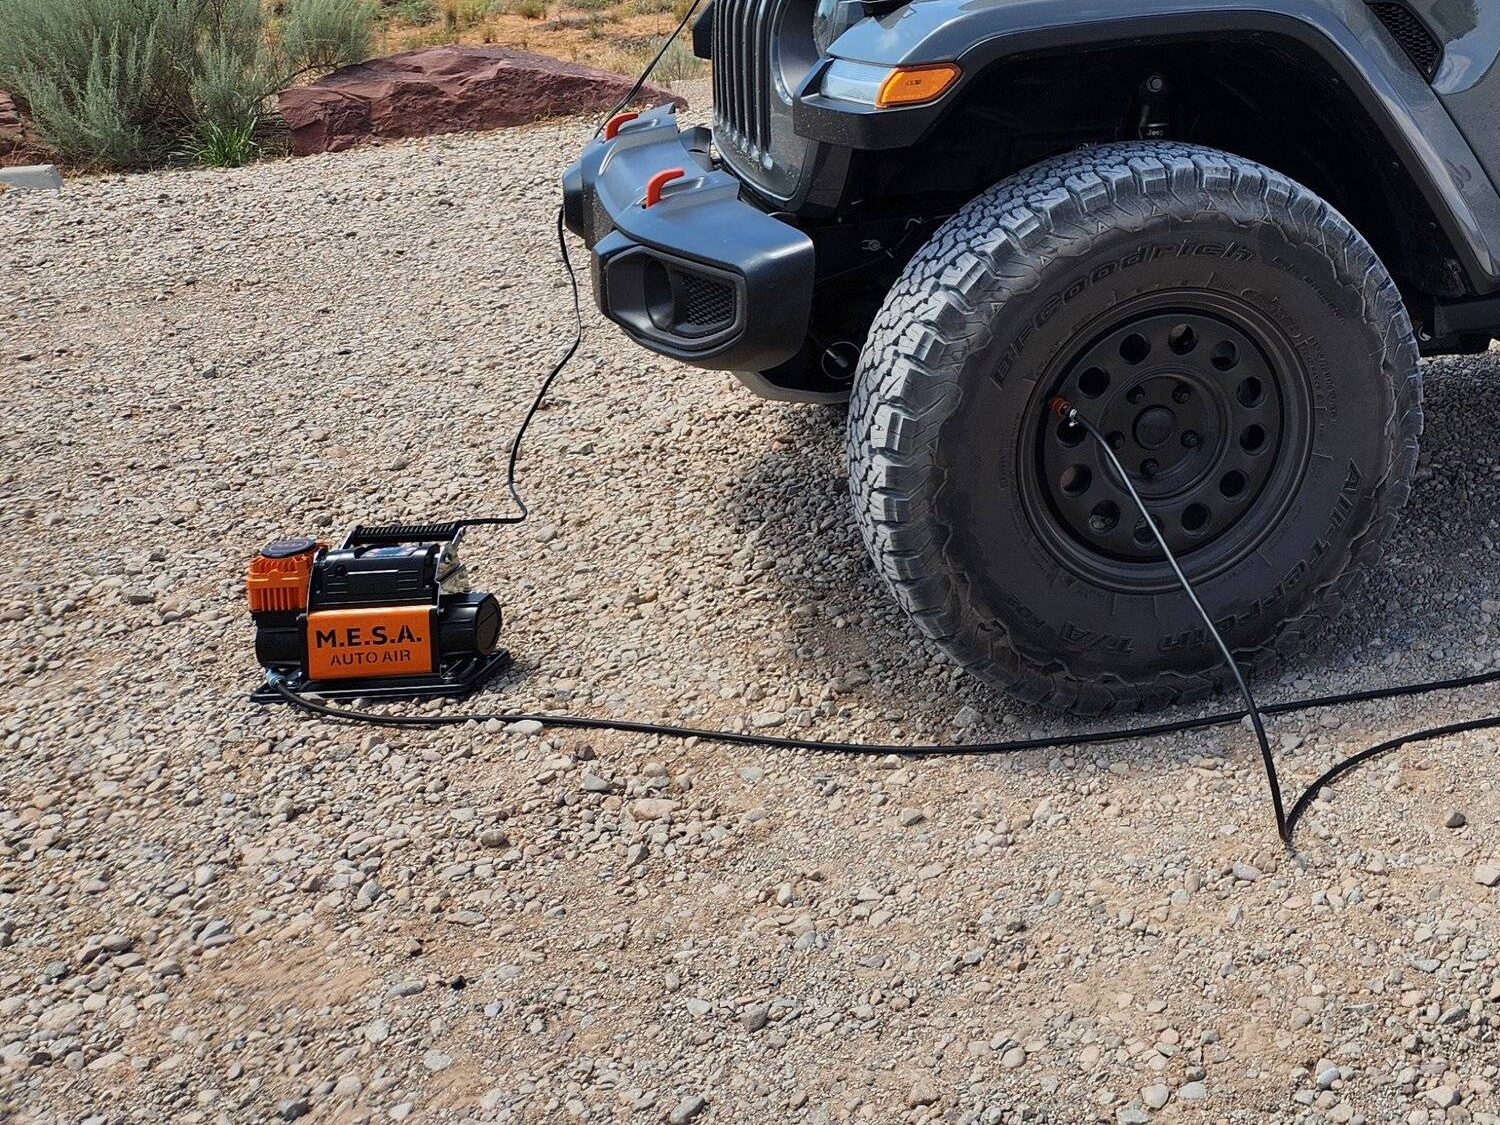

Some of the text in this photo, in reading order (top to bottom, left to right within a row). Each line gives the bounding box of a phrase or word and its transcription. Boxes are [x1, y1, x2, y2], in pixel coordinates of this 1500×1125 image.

[315, 625, 422, 649] M.E.S.A.
[330, 649, 412, 667] AUTO AIR
